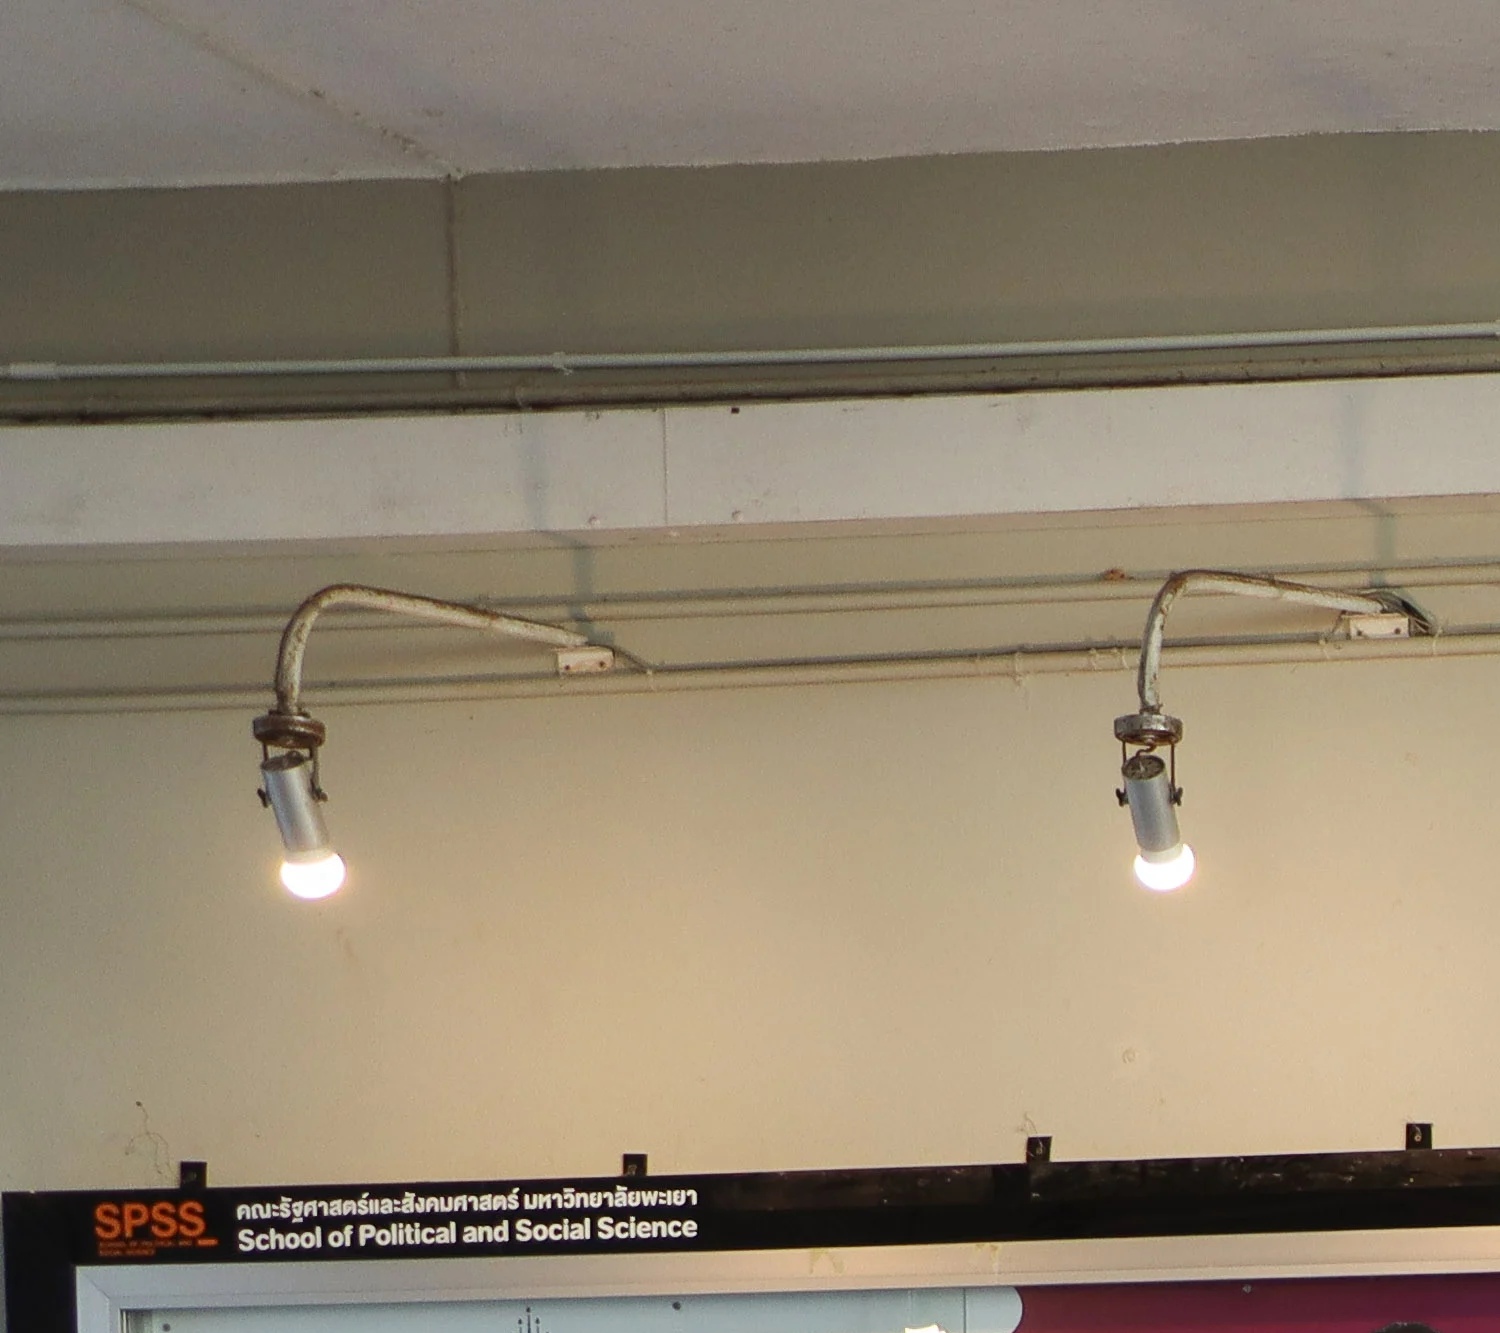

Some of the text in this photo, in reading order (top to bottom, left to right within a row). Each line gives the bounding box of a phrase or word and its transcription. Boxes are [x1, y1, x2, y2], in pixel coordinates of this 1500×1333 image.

[95, 1201, 206, 1239] SPSS
[236, 1184, 698, 1223] คณะรัฐศาสตร์และสังคมศาสตร์ มหาวิทยาลัยพะเยา
[238, 1215, 698, 1252] School of Political and Social Science
